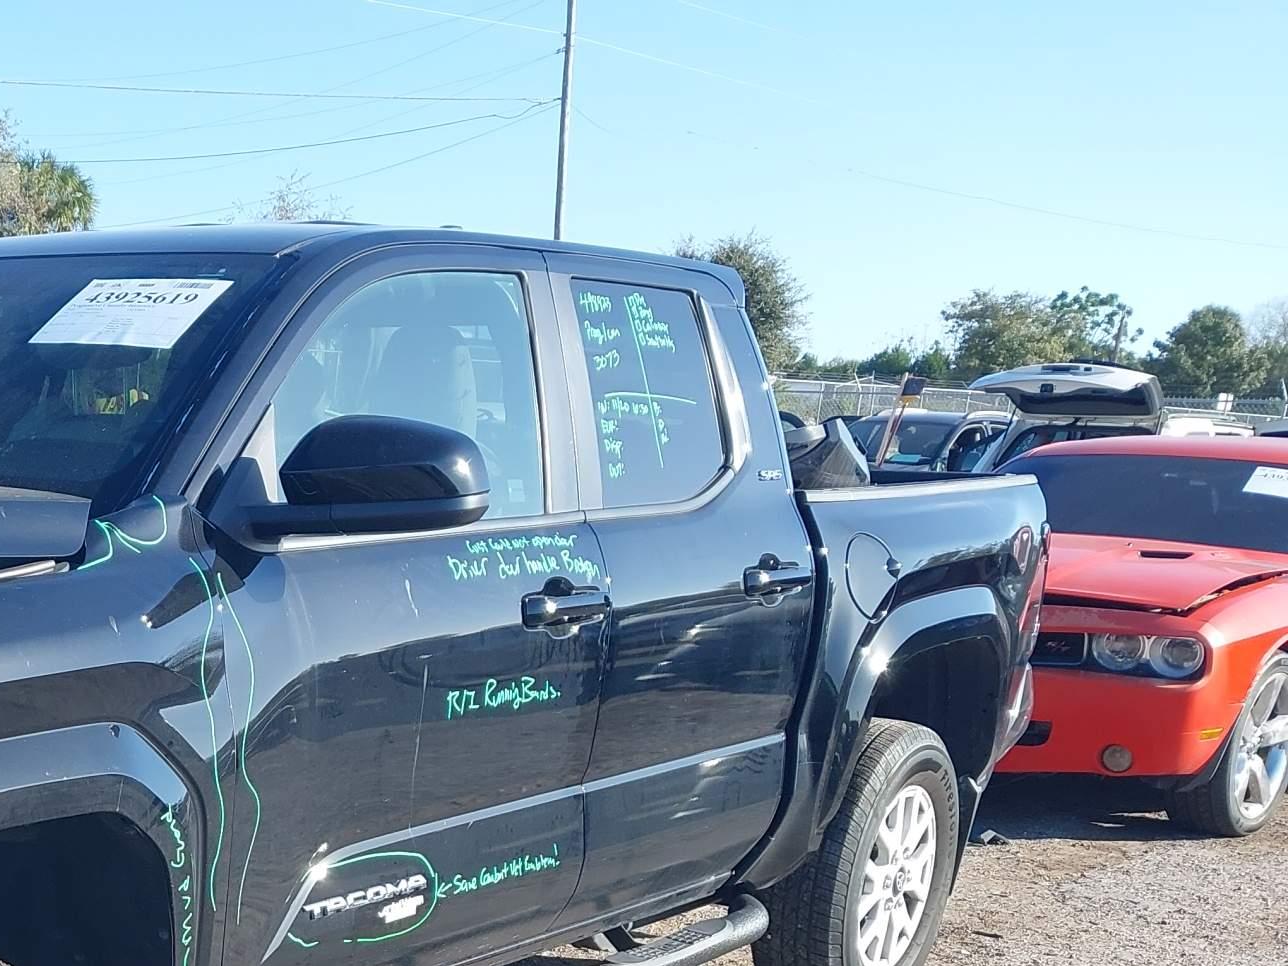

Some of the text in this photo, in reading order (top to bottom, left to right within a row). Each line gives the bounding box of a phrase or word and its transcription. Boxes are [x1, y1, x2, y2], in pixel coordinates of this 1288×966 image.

[85, 291, 199, 305] 43925619
[758, 469, 782, 481] SR5
[302, 873, 428, 921] TACOMA
